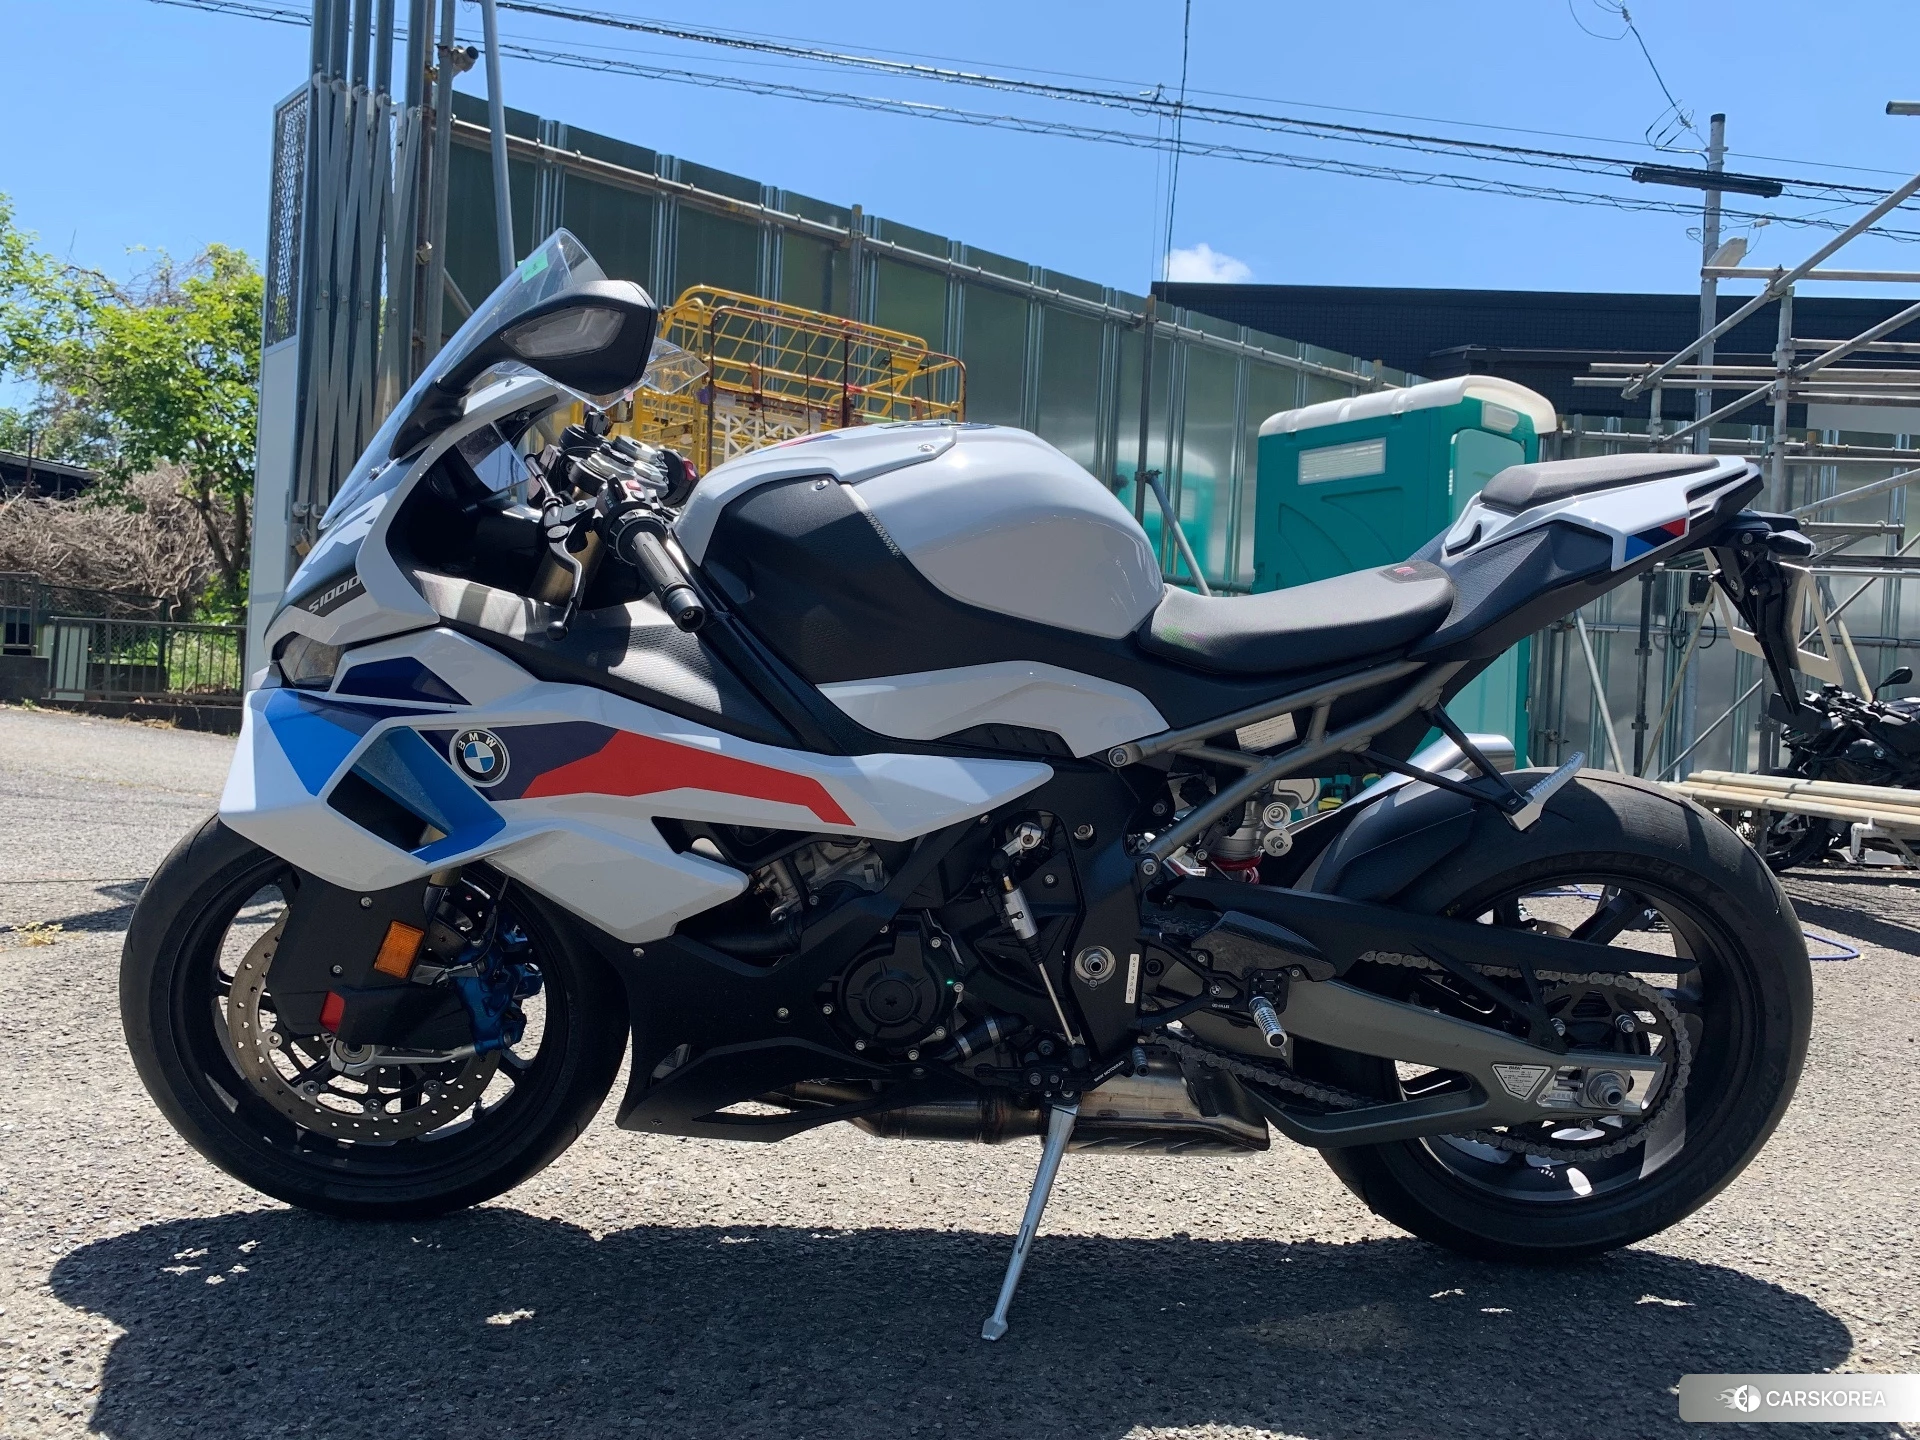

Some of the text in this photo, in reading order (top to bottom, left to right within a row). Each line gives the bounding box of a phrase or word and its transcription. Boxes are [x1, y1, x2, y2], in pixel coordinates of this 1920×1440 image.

[308, 575, 362, 614] S1000
[458, 732, 496, 750] BMW
[1530, 854, 1684, 880] METZELER
